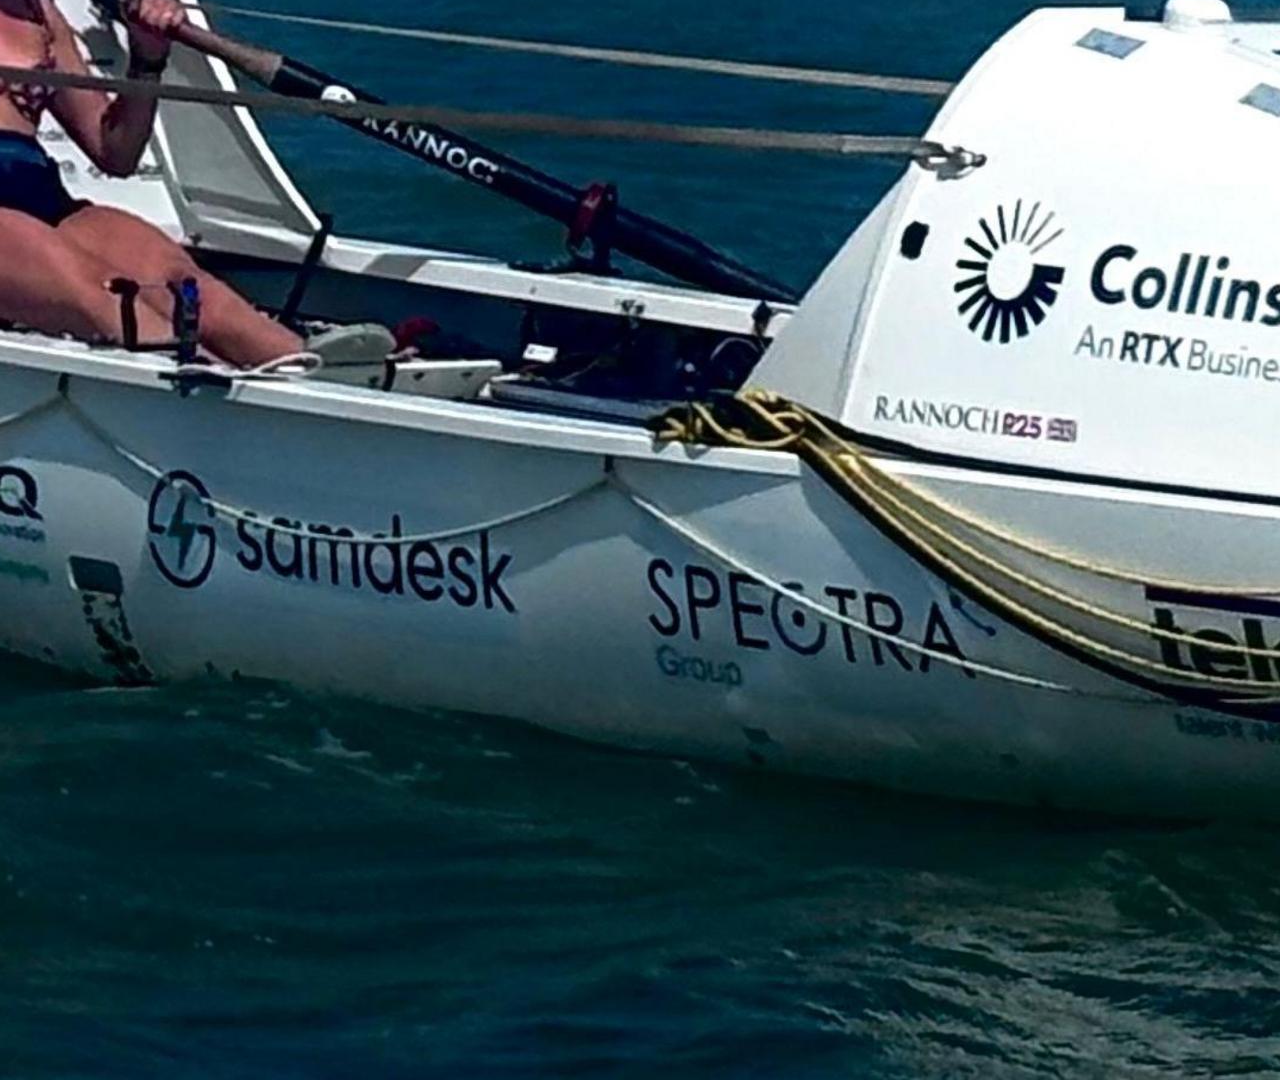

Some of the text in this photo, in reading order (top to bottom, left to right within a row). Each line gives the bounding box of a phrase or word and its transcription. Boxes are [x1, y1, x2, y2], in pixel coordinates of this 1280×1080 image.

[1074, 324, 1115, 360] An
[1119, 330, 1184, 369] RTX
[873, 395, 1000, 435] RANNOCH
[236, 511, 517, 615] samdesk
[647, 557, 976, 679] SPECTRA
